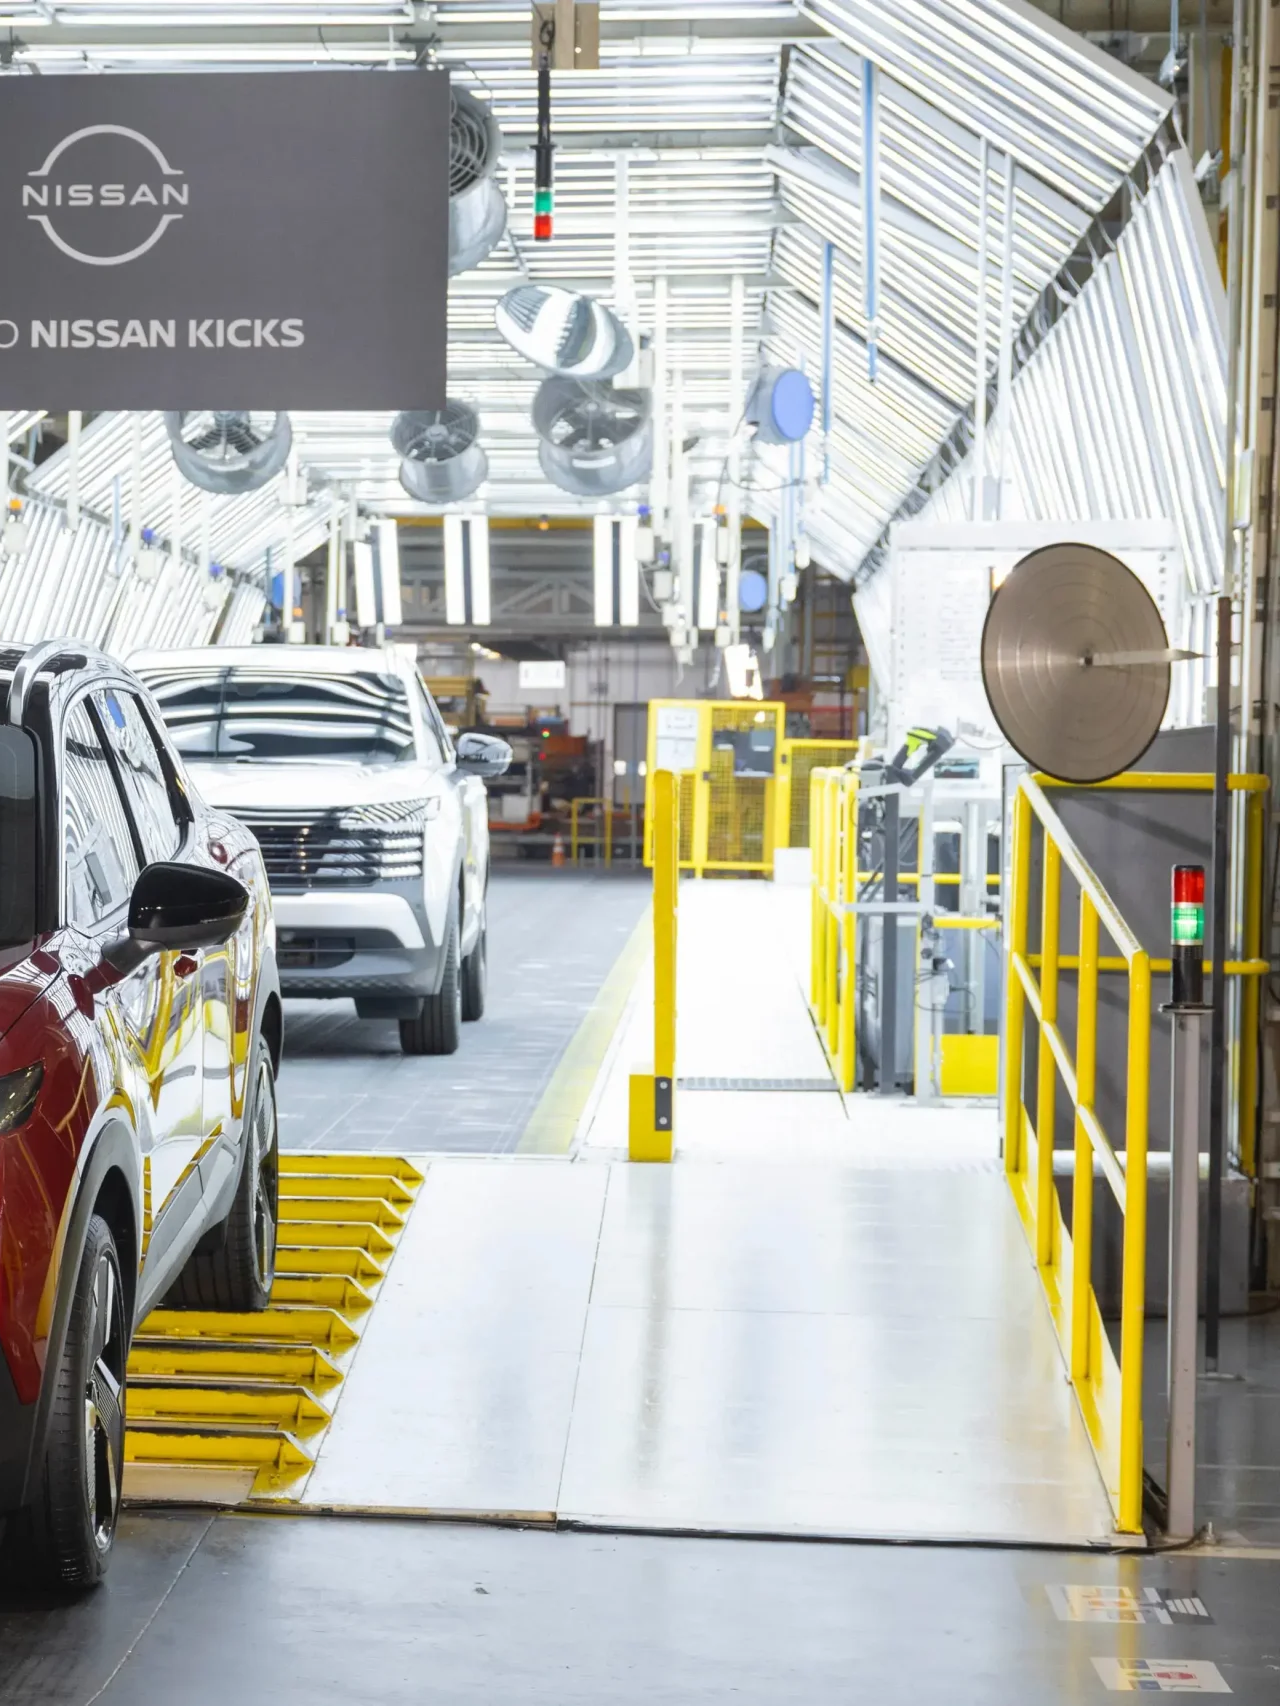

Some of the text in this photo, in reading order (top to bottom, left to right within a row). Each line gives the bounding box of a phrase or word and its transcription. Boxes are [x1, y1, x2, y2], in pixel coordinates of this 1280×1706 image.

[22, 183, 189, 206] NISSAN
[30, 319, 176, 348] NISSAN
[188, 318, 305, 348] KICKS
